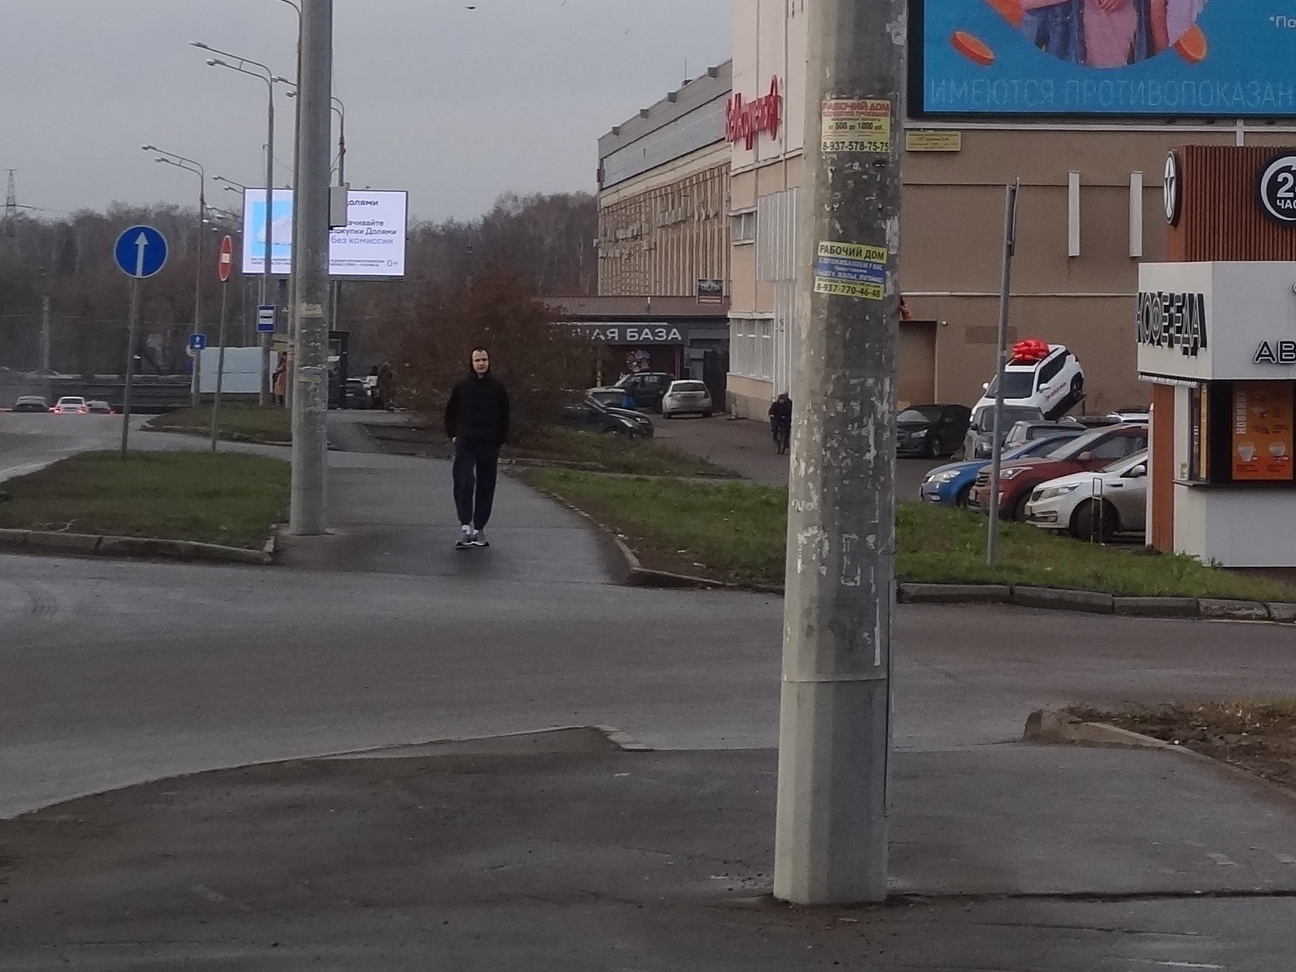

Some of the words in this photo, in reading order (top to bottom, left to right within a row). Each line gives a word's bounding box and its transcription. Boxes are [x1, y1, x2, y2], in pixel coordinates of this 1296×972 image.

[930, 79, 1054, 106] ИМЕЮТСЯ
[822, 101, 868, 111] РАБОЧИЙ
[869, 102, 889, 111] ДОМ
[823, 141, 889, 151] 8-937-578-75-75
[347, 199, 379, 207] олями
[365, 228, 397, 236] Долями
[330, 235, 347, 244] без
[348, 237, 394, 245] комиссии
[820, 244, 863, 257] РАБОЧИЙ
[864, 249, 885, 261] ДОМ
[816, 283, 881, 298] 8-937-770-46-48
[626, 328, 682, 341] БАЗА
